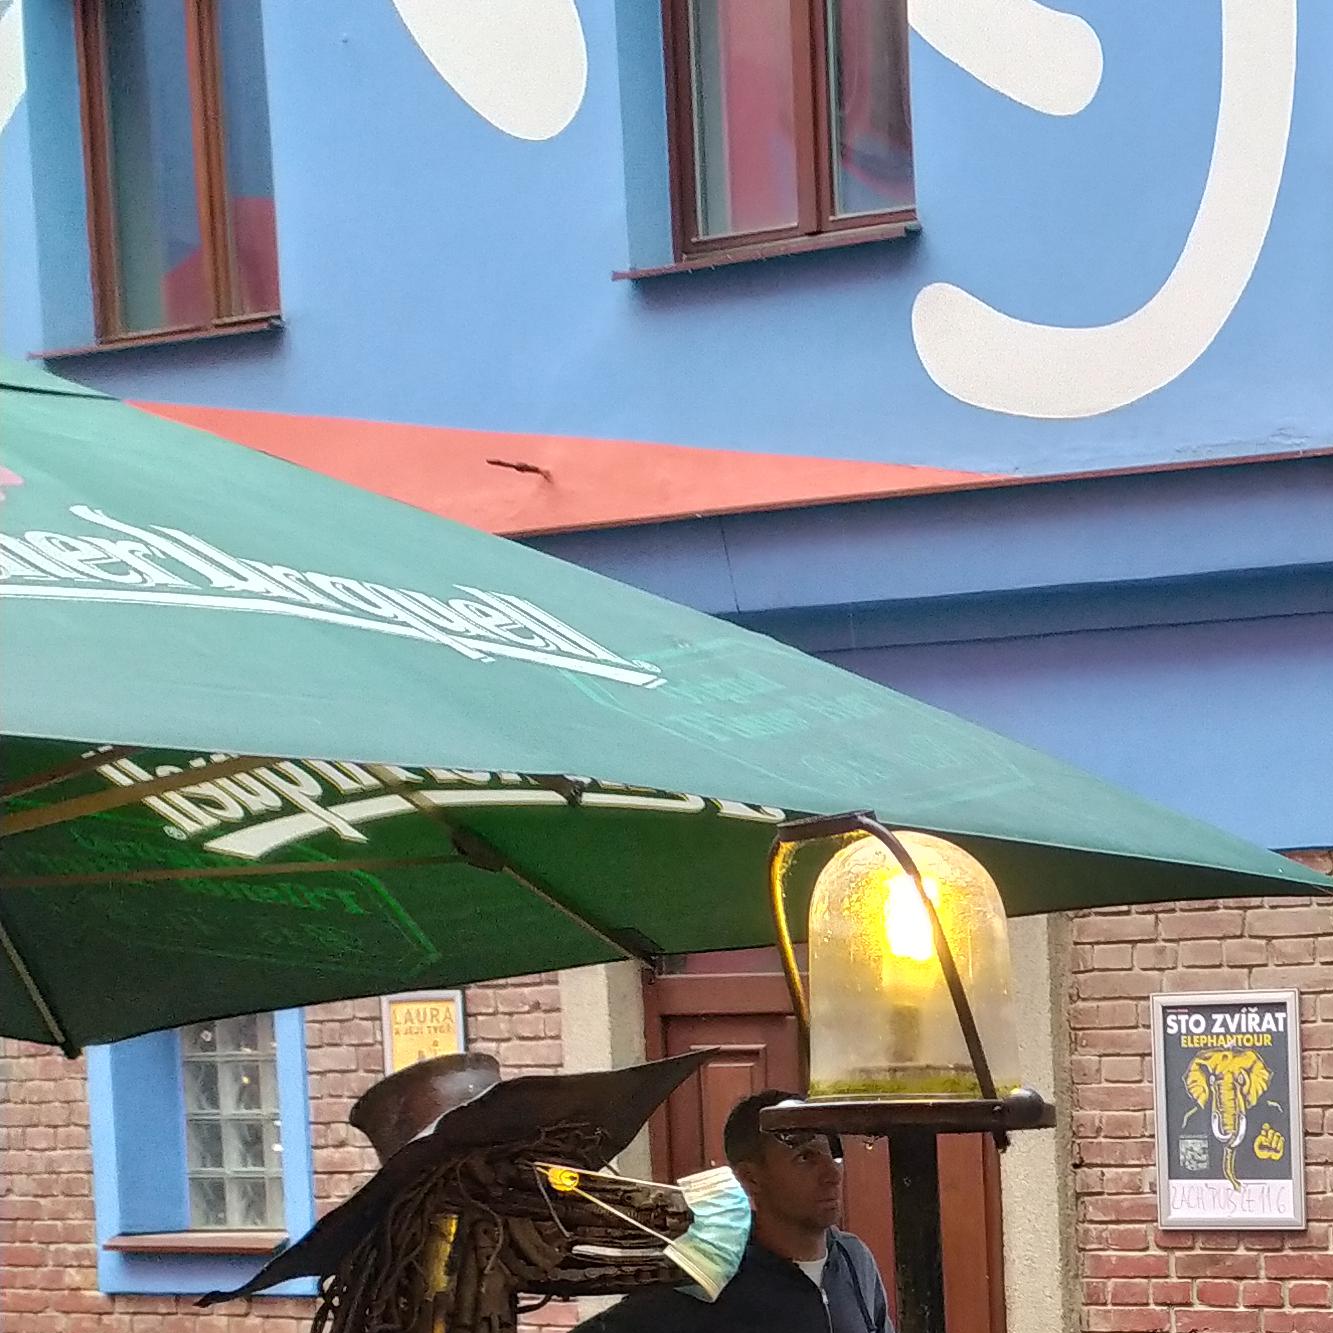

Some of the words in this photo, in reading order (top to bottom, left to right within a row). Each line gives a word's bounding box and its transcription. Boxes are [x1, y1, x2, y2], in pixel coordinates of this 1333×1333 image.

[392, 1006, 455, 1025] LAURA
[1166, 1013, 1206, 1035] STO
[1211, 1006, 1287, 1034] ZVÍŘAT
[1181, 1034, 1273, 1048] ELEPHANTOUR
